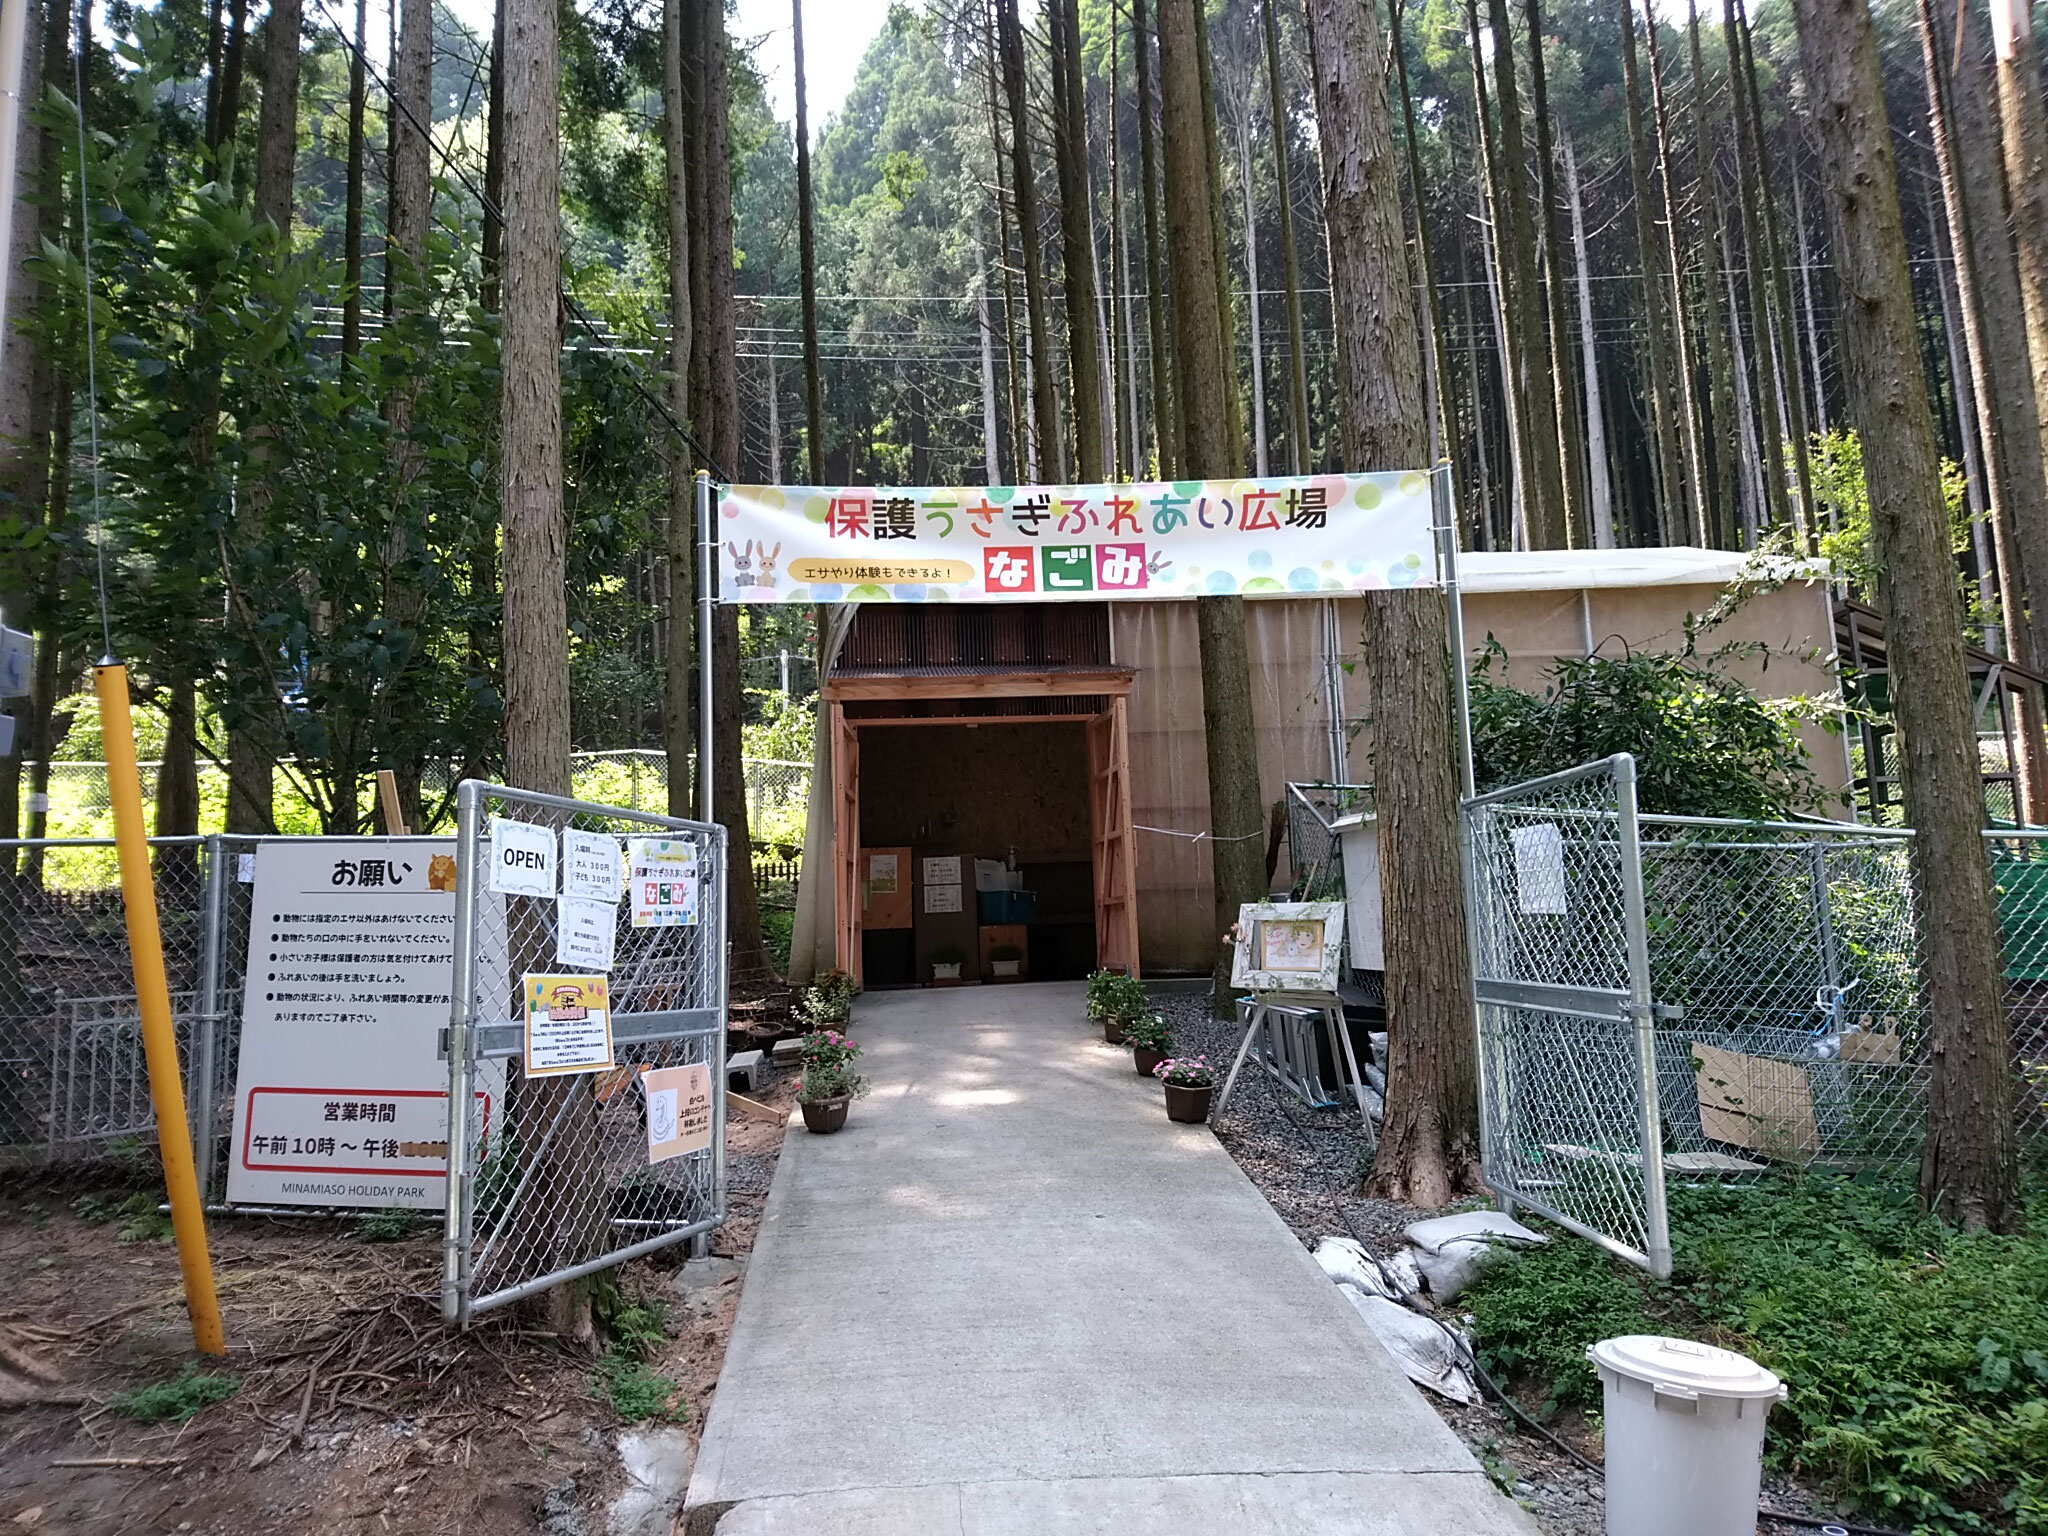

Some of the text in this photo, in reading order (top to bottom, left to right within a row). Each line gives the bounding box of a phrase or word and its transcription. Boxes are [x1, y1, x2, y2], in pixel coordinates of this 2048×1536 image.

[825, 488, 1328, 540] 保護うさぎふれあい広場
[804, 565, 951, 579] エサやり体験もできるよ！
[986, 545, 1145, 590] なごみ
[503, 848, 545, 871] OPEN
[331, 859, 413, 887] お願い
[645, 884, 683, 904] なごみ
[281, 934, 450, 943] 動物たちの口の中に手をいれないでください。
[279, 953, 491, 964] 小さいお子様は保護者の方は気を付けてあげてい。
[277, 973, 405, 983] ふれあいの後は手を洗いましょう。
[275, 993, 483, 1004] 動物の状況により、ふれあい時間等の変更があも
[274, 1013, 377, 1024] ありますのでご了承下さい。
[323, 1102, 396, 1123] 営業時間
[281, 1183, 425, 1198] MINAMIASO HOLIDAY PARK
